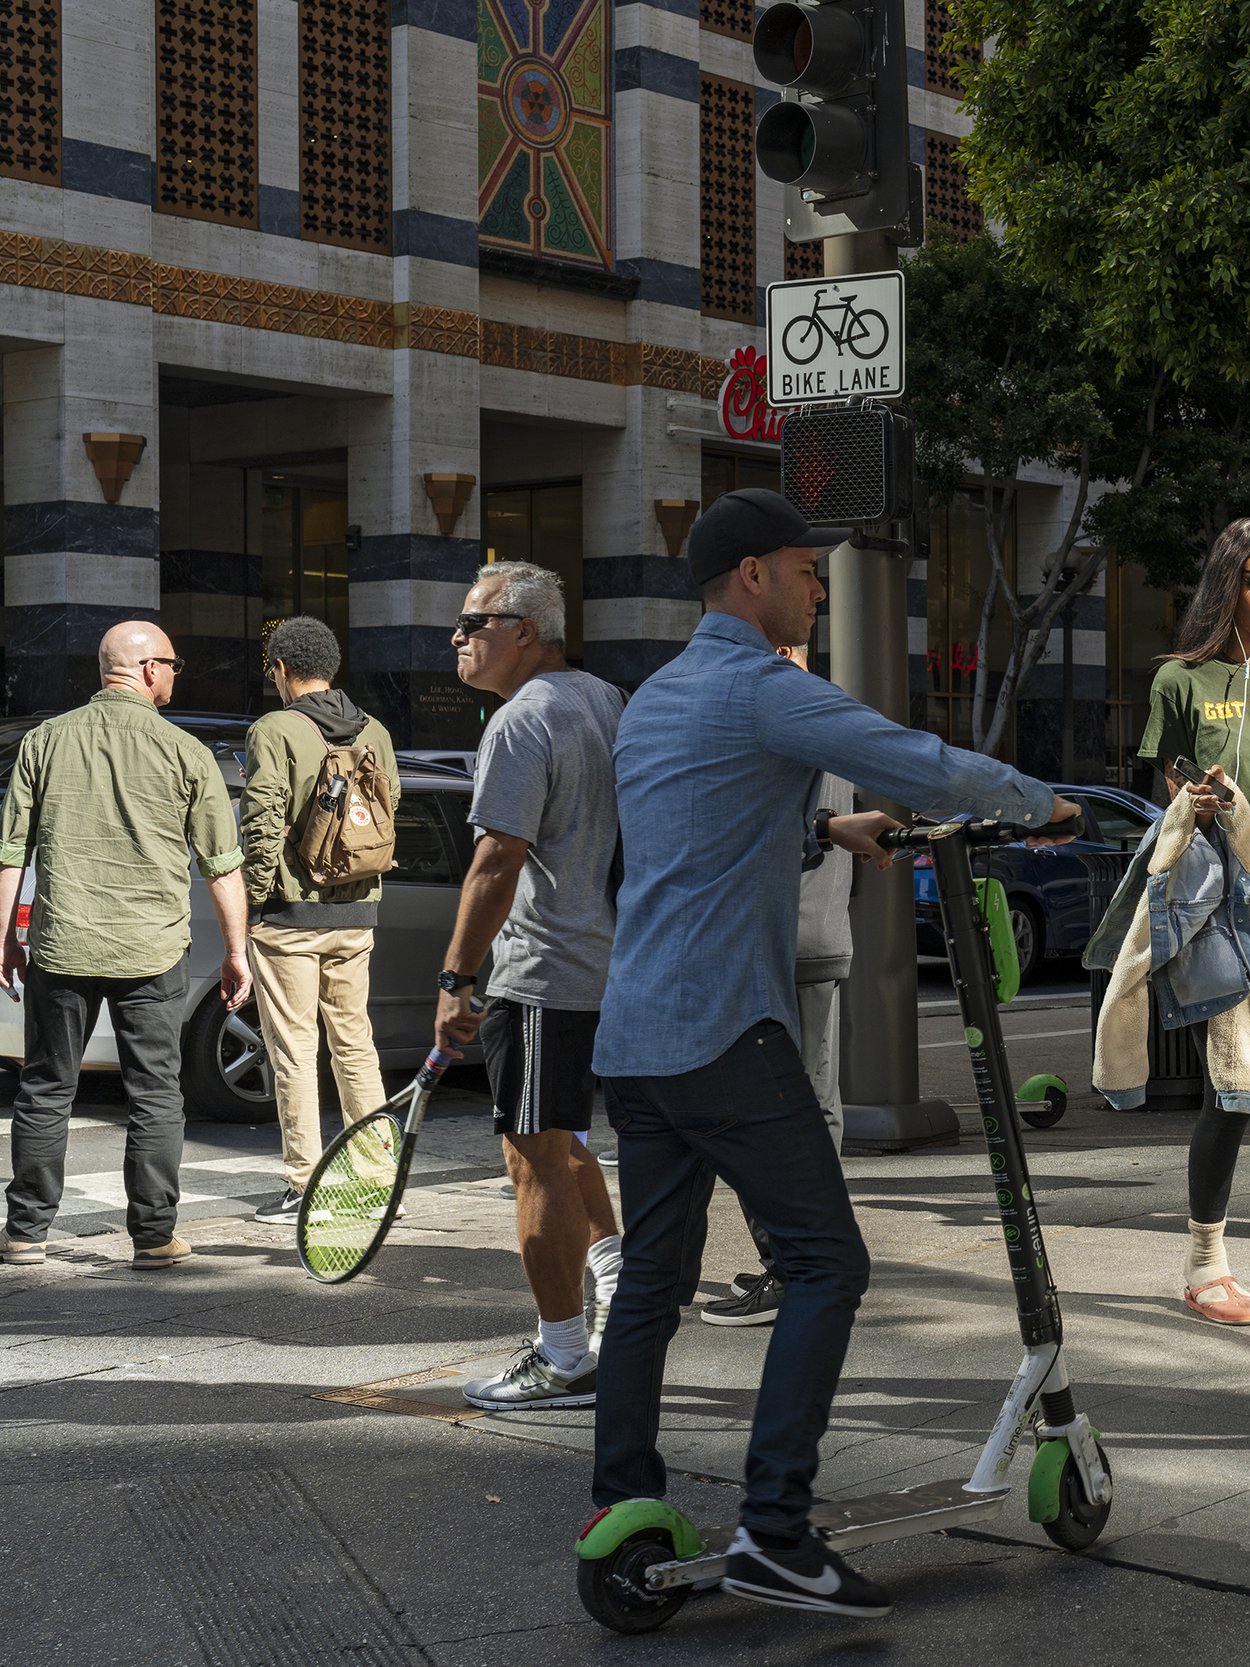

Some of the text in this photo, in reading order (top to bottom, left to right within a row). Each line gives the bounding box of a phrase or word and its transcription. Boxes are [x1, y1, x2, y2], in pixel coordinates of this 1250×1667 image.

[782, 366, 890, 396] BIKE LANE
[1203, 700, 1244, 720] GOT
